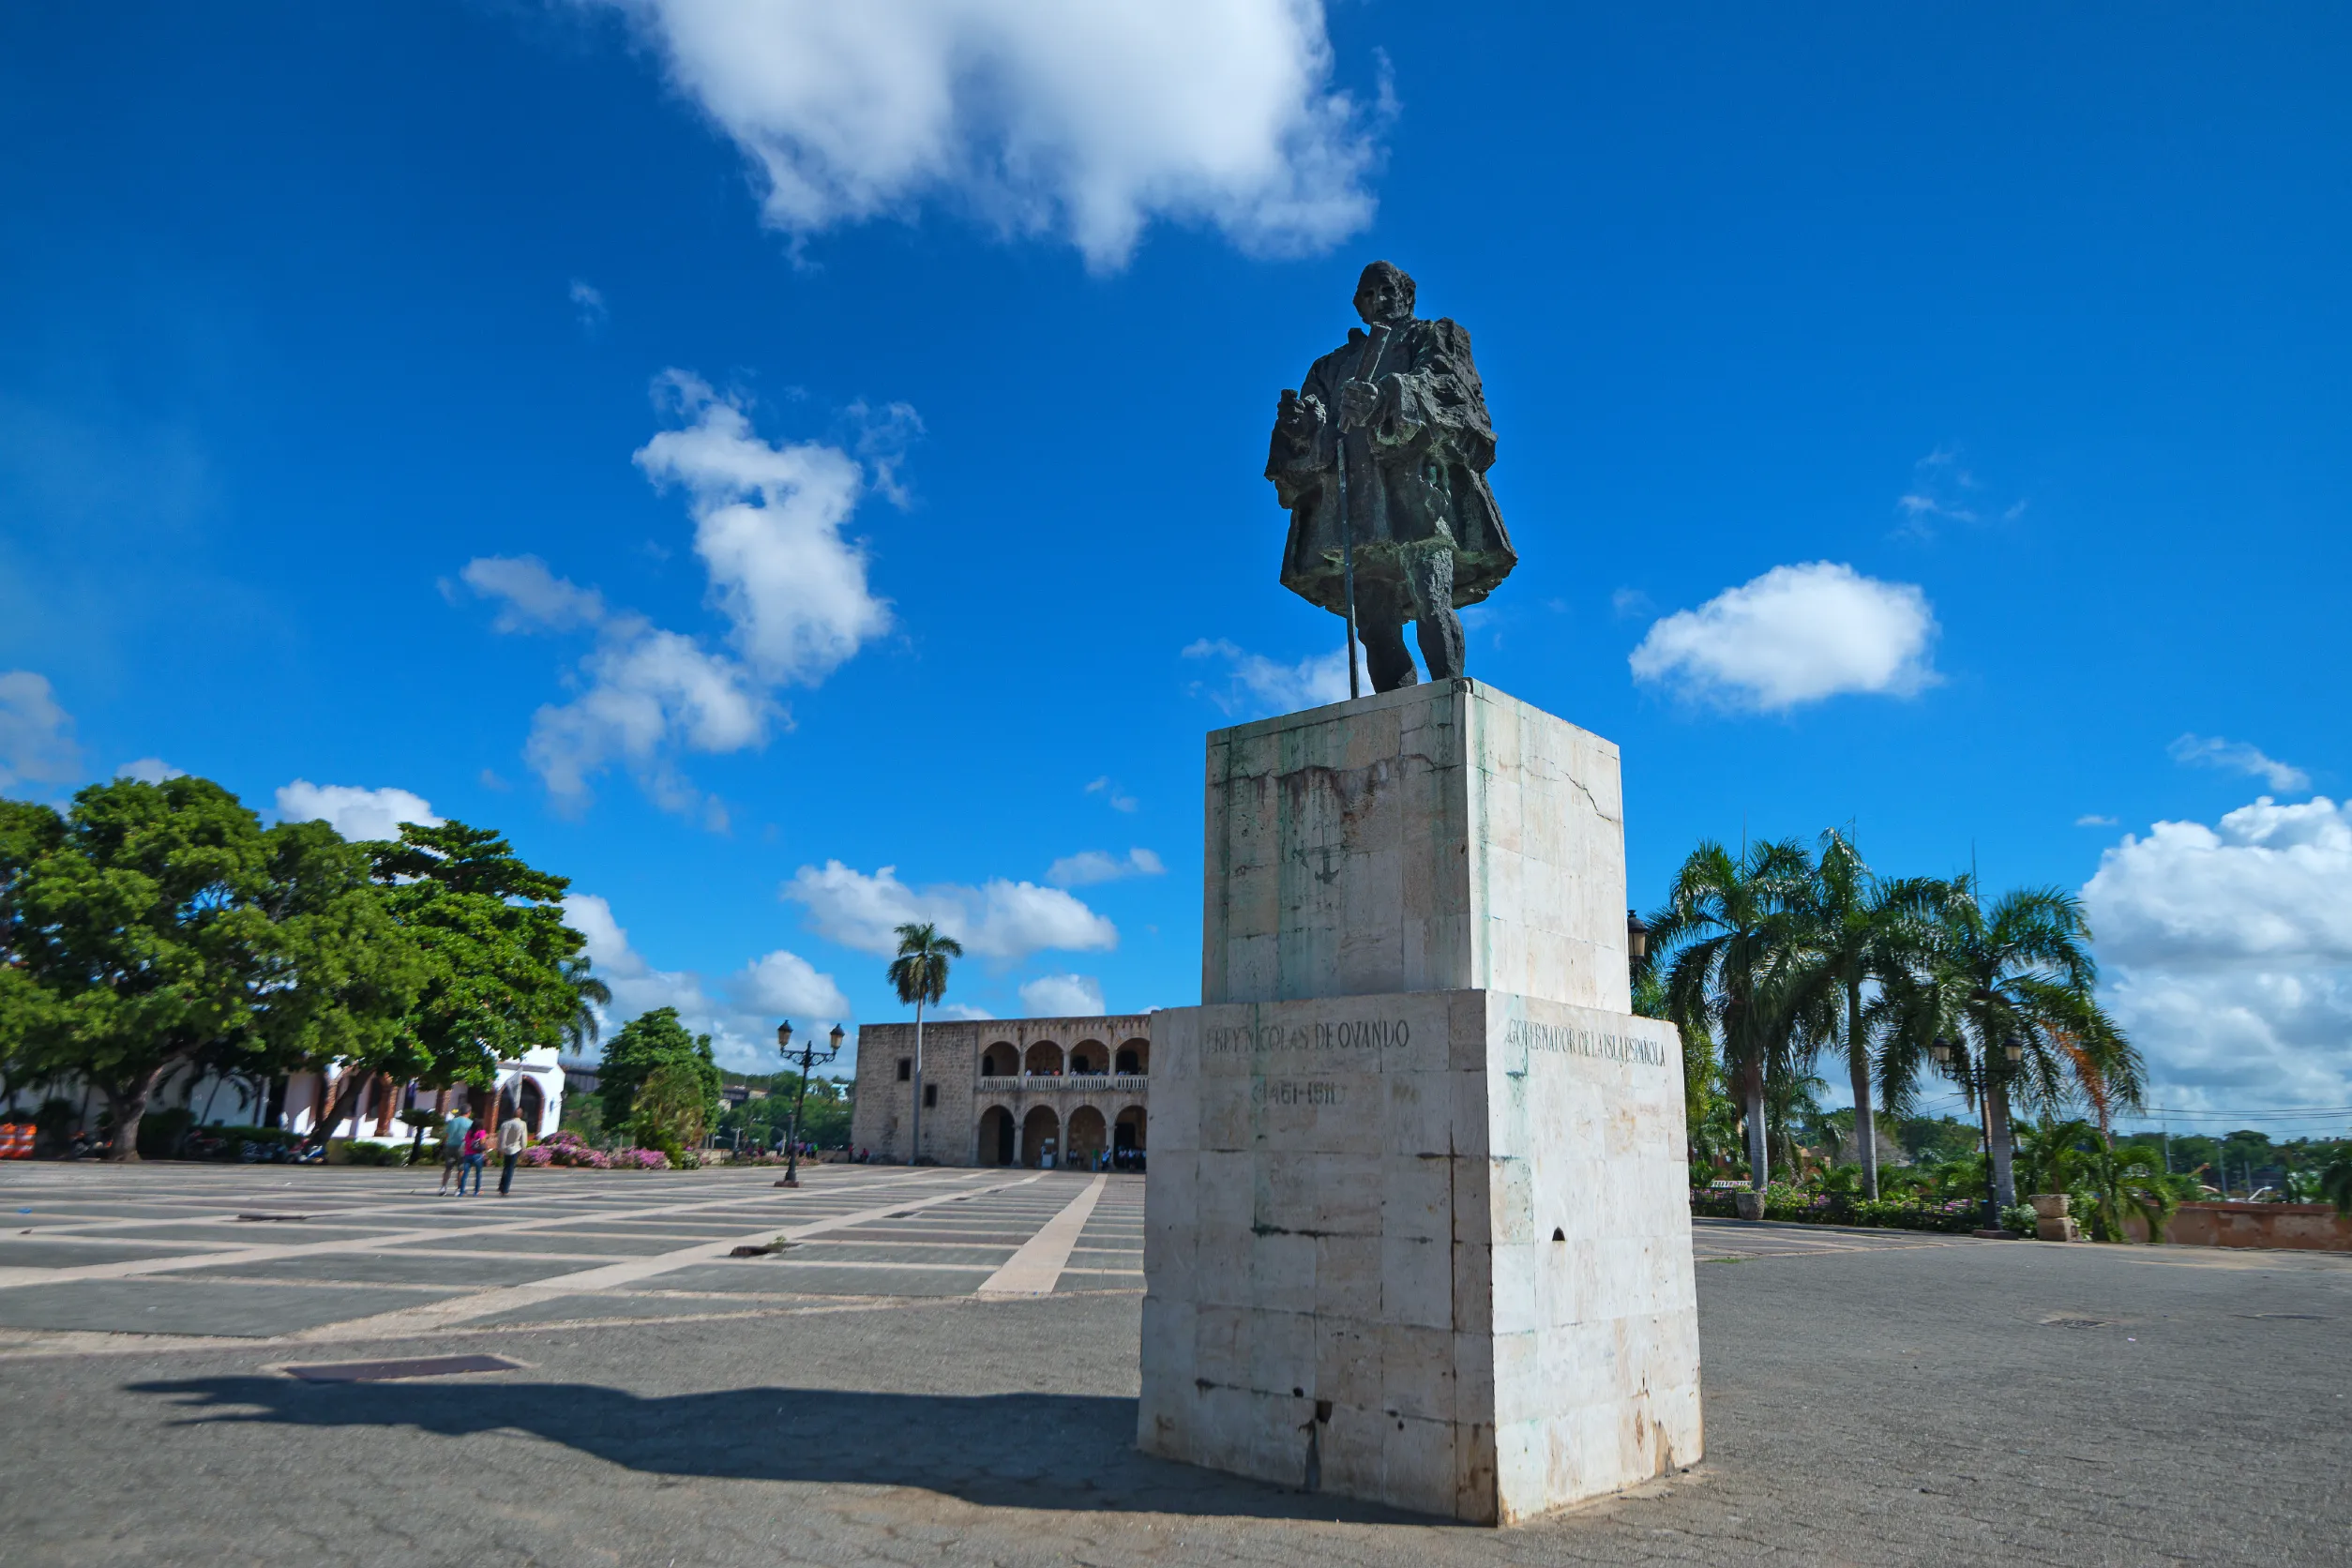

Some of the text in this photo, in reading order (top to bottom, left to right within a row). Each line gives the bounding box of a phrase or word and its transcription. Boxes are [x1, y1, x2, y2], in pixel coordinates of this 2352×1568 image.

[1315, 1021, 1334, 1049] DE
[1337, 1018, 1410, 1048] OVANDO
[1508, 1018, 1576, 1054] GOBERNADOR
[1577, 1029, 1590, 1058] DE
